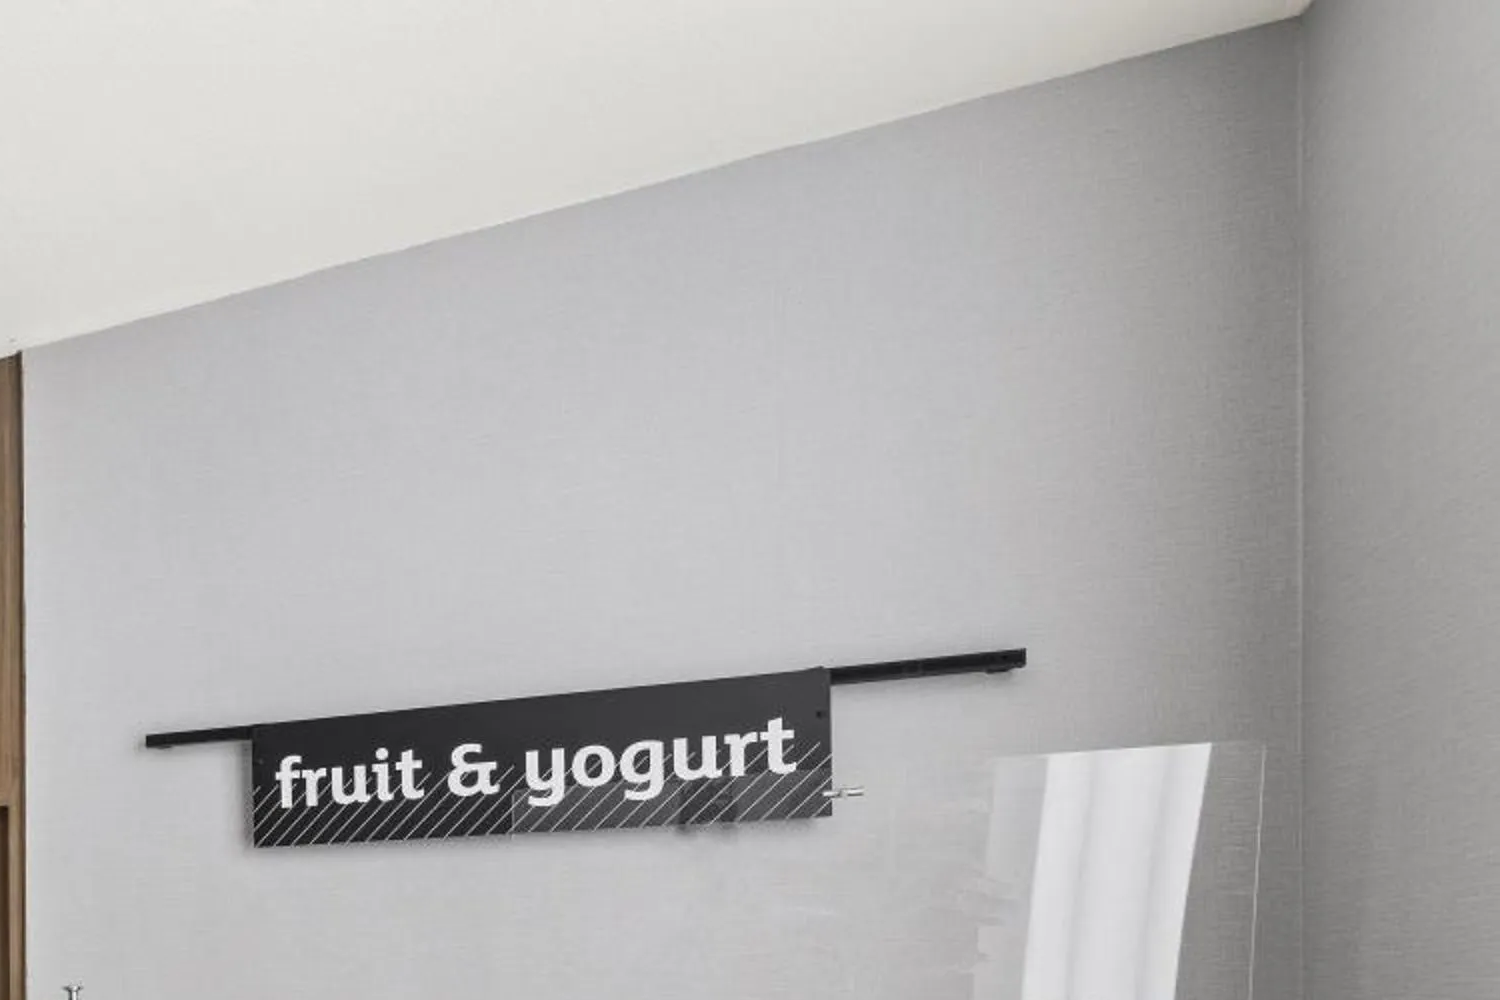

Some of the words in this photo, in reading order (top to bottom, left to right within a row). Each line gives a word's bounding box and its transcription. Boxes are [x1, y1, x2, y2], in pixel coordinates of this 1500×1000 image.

[275, 747, 425, 809] fruit
[447, 743, 500, 797] &
[525, 717, 797, 807] yogurt
